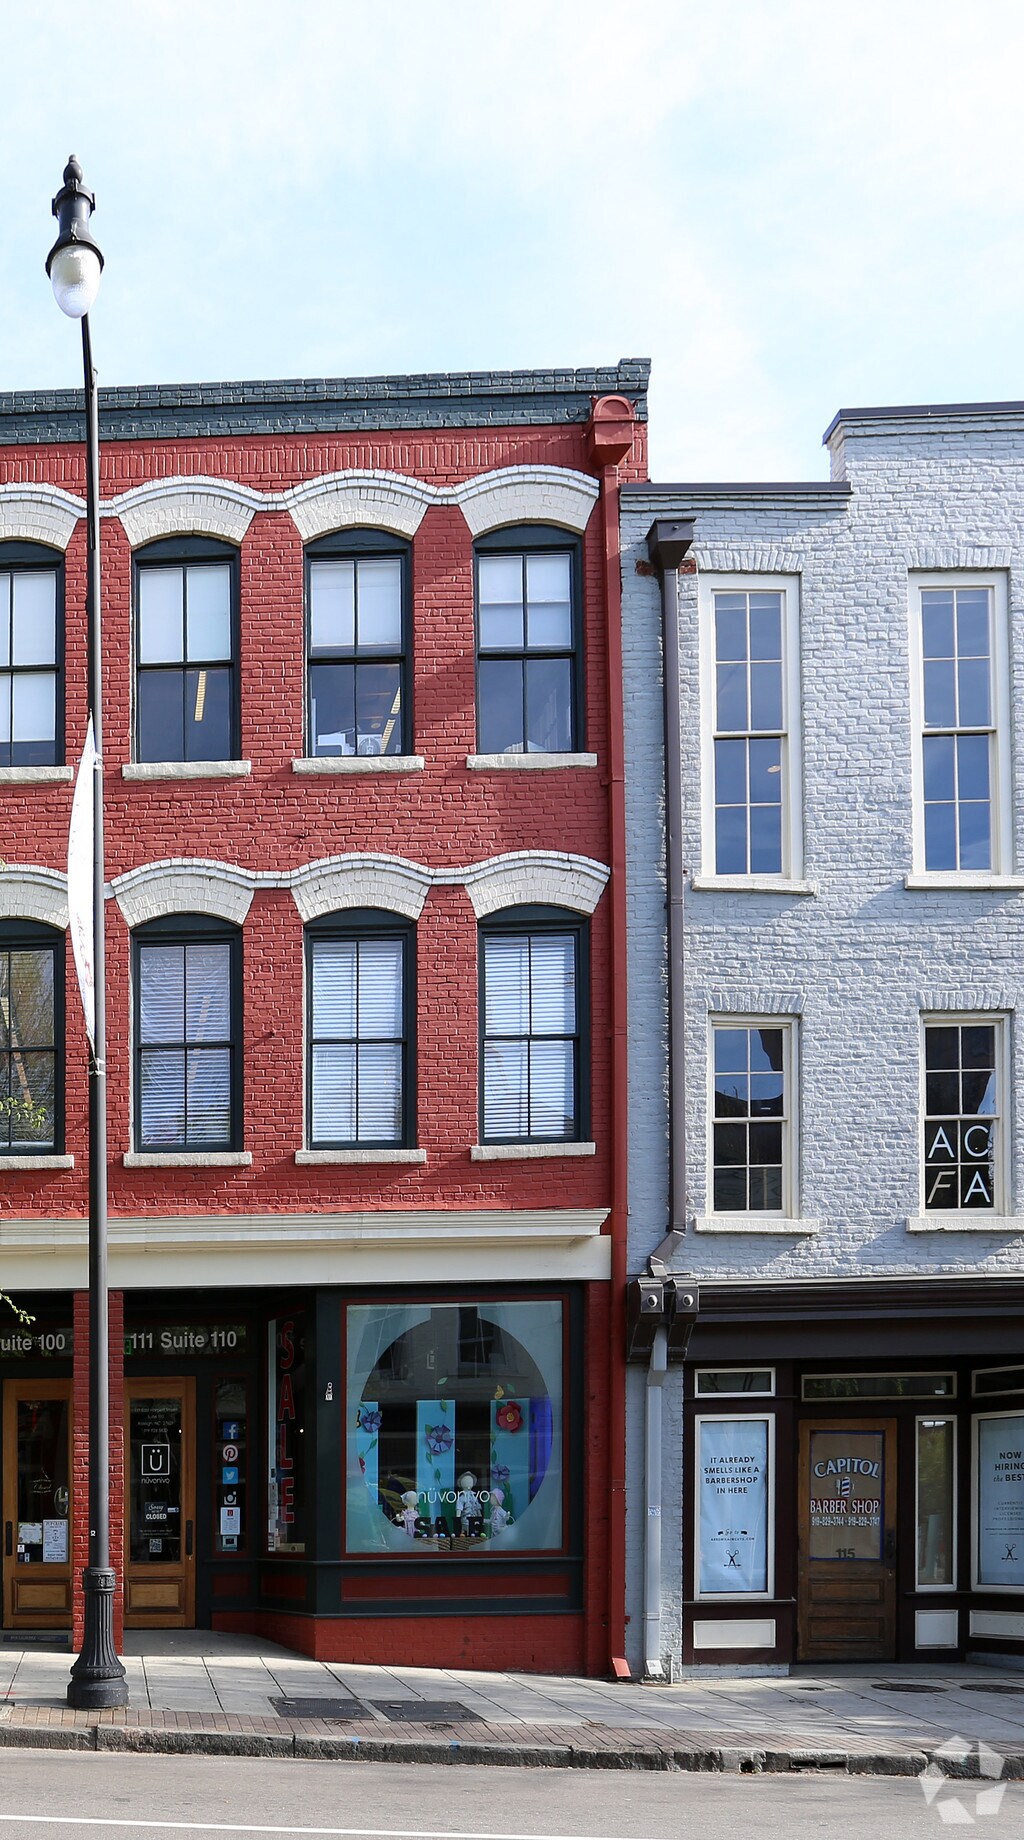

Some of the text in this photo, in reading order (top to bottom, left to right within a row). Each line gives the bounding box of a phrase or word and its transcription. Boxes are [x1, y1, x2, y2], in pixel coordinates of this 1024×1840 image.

[38, 1334, 66, 1350] 100
[130, 1331, 237, 1349] 111 Suite 110
[814, 1458, 880, 1478] CAPITOL
[705, 1476, 758, 1484] BARBERSHOP
[418, 1488, 491, 1504] nüvonvo
[810, 1499, 880, 1514] BARBER SHOP
[836, 1547, 856, 1559] 115
